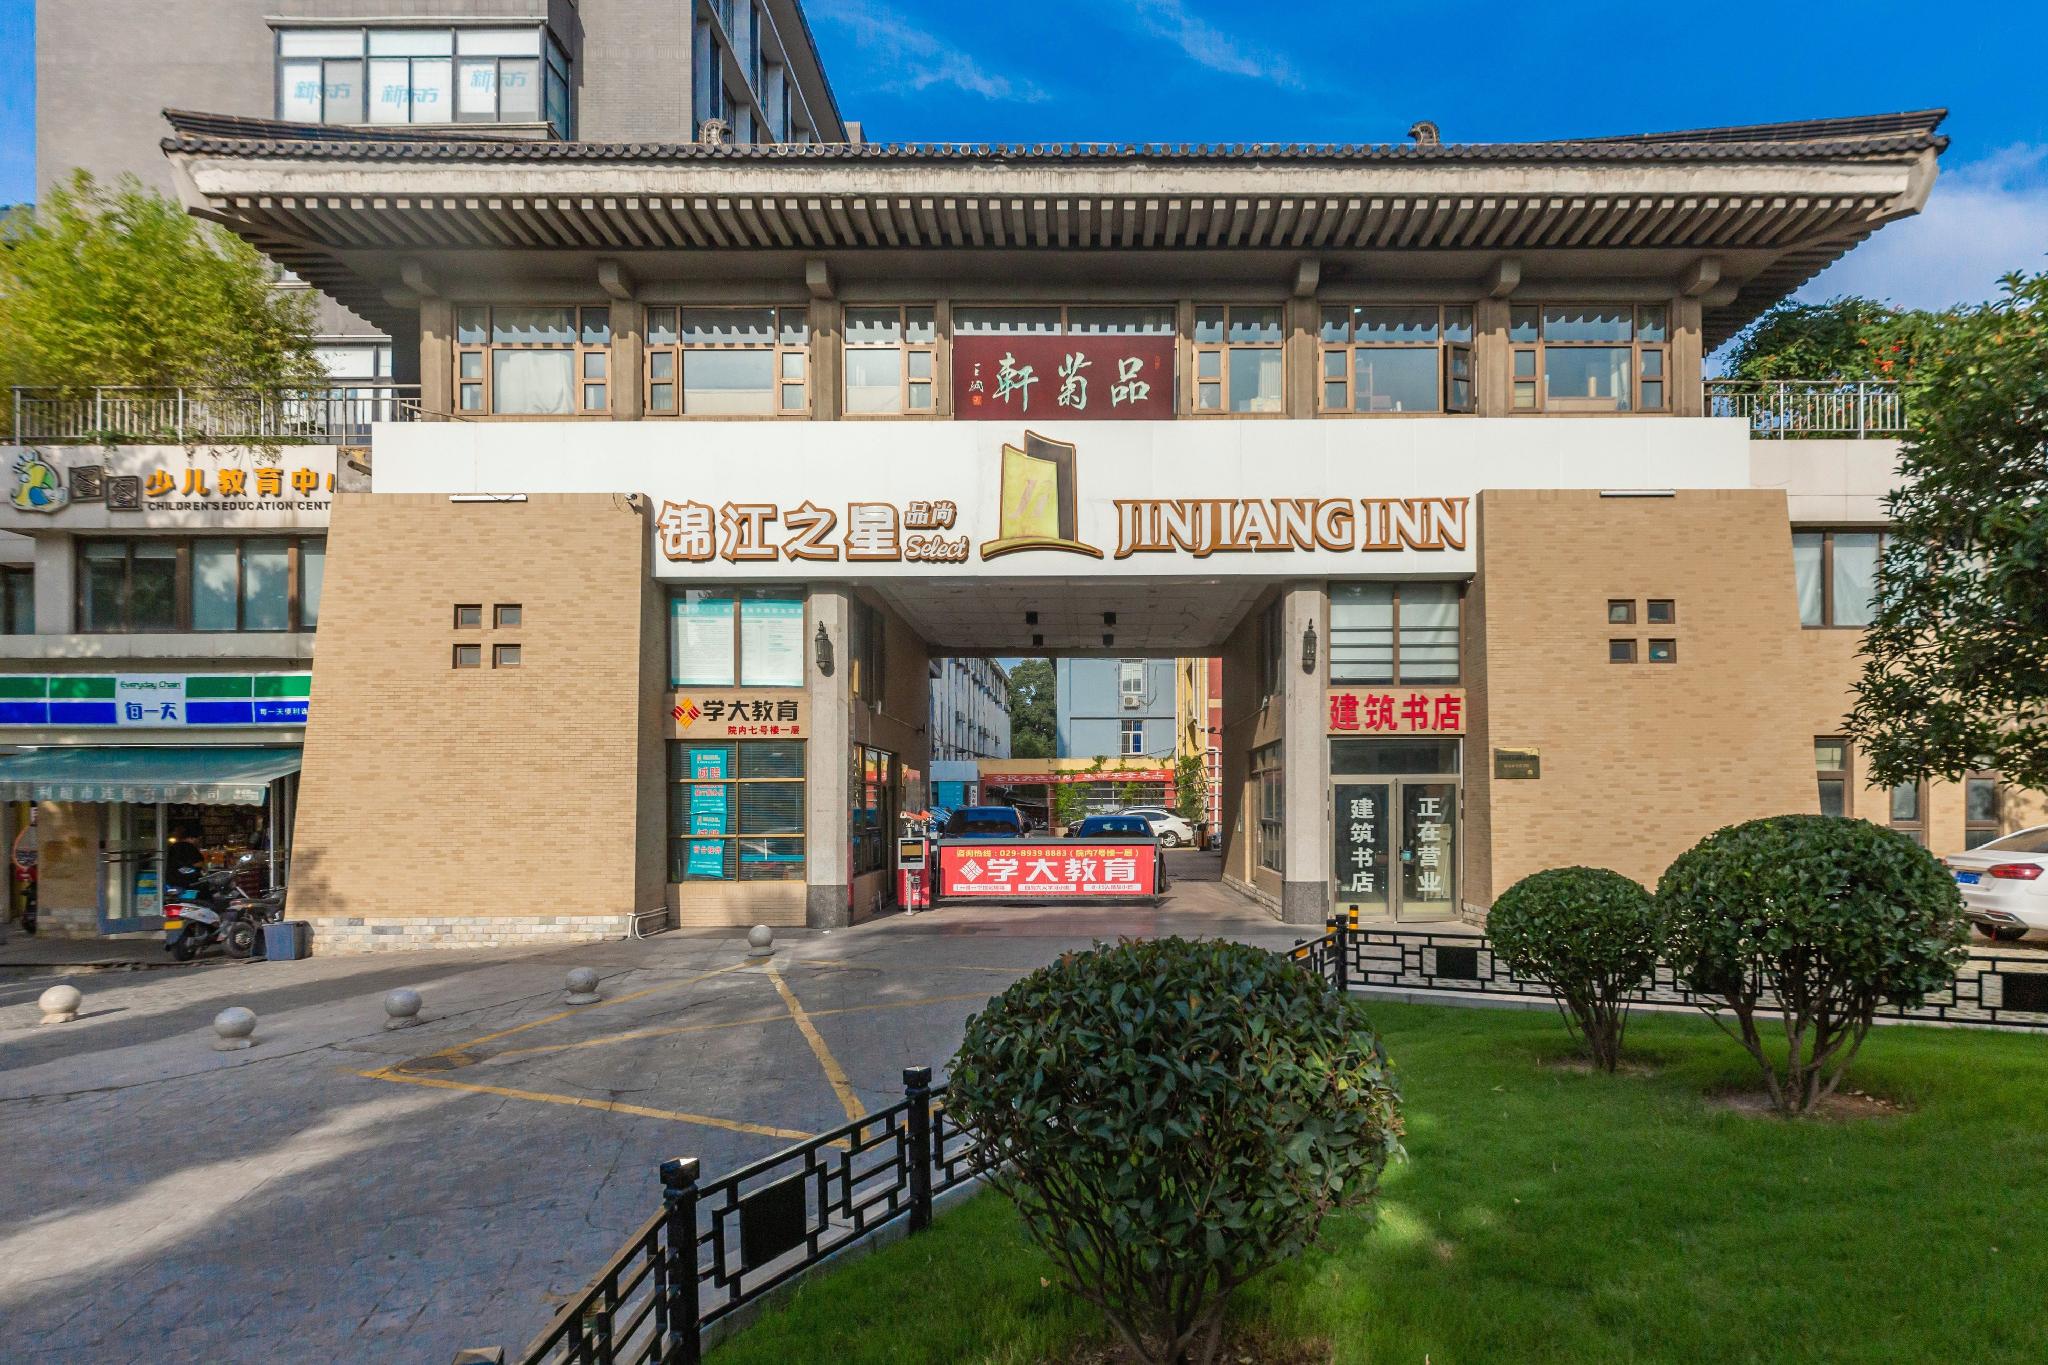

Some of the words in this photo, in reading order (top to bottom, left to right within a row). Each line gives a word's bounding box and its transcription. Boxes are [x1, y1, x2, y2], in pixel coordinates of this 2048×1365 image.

[144, 467, 335, 497] 少儿教育中
[221, 501, 294, 511] EDUCATION
[905, 501, 957, 529] 品尚
[657, 500, 902, 563] 锦江之星
[1113, 498, 1355, 559] JINJIANG
[1361, 497, 1470, 552] INN
[904, 534, 970, 562] Select
[120, 680, 157, 690] Everyday
[124, 701, 178, 721] 每一天
[703, 700, 799, 721] 学大教育
[1329, 692, 1462, 732] 建筑书店
[727, 725, 800, 735] 院内七号楼一层
[1350, 798, 1375, 893] 建筑书店
[1417, 797, 1441, 893] 正在营业
[986, 857, 1136, 882] 学大教育
